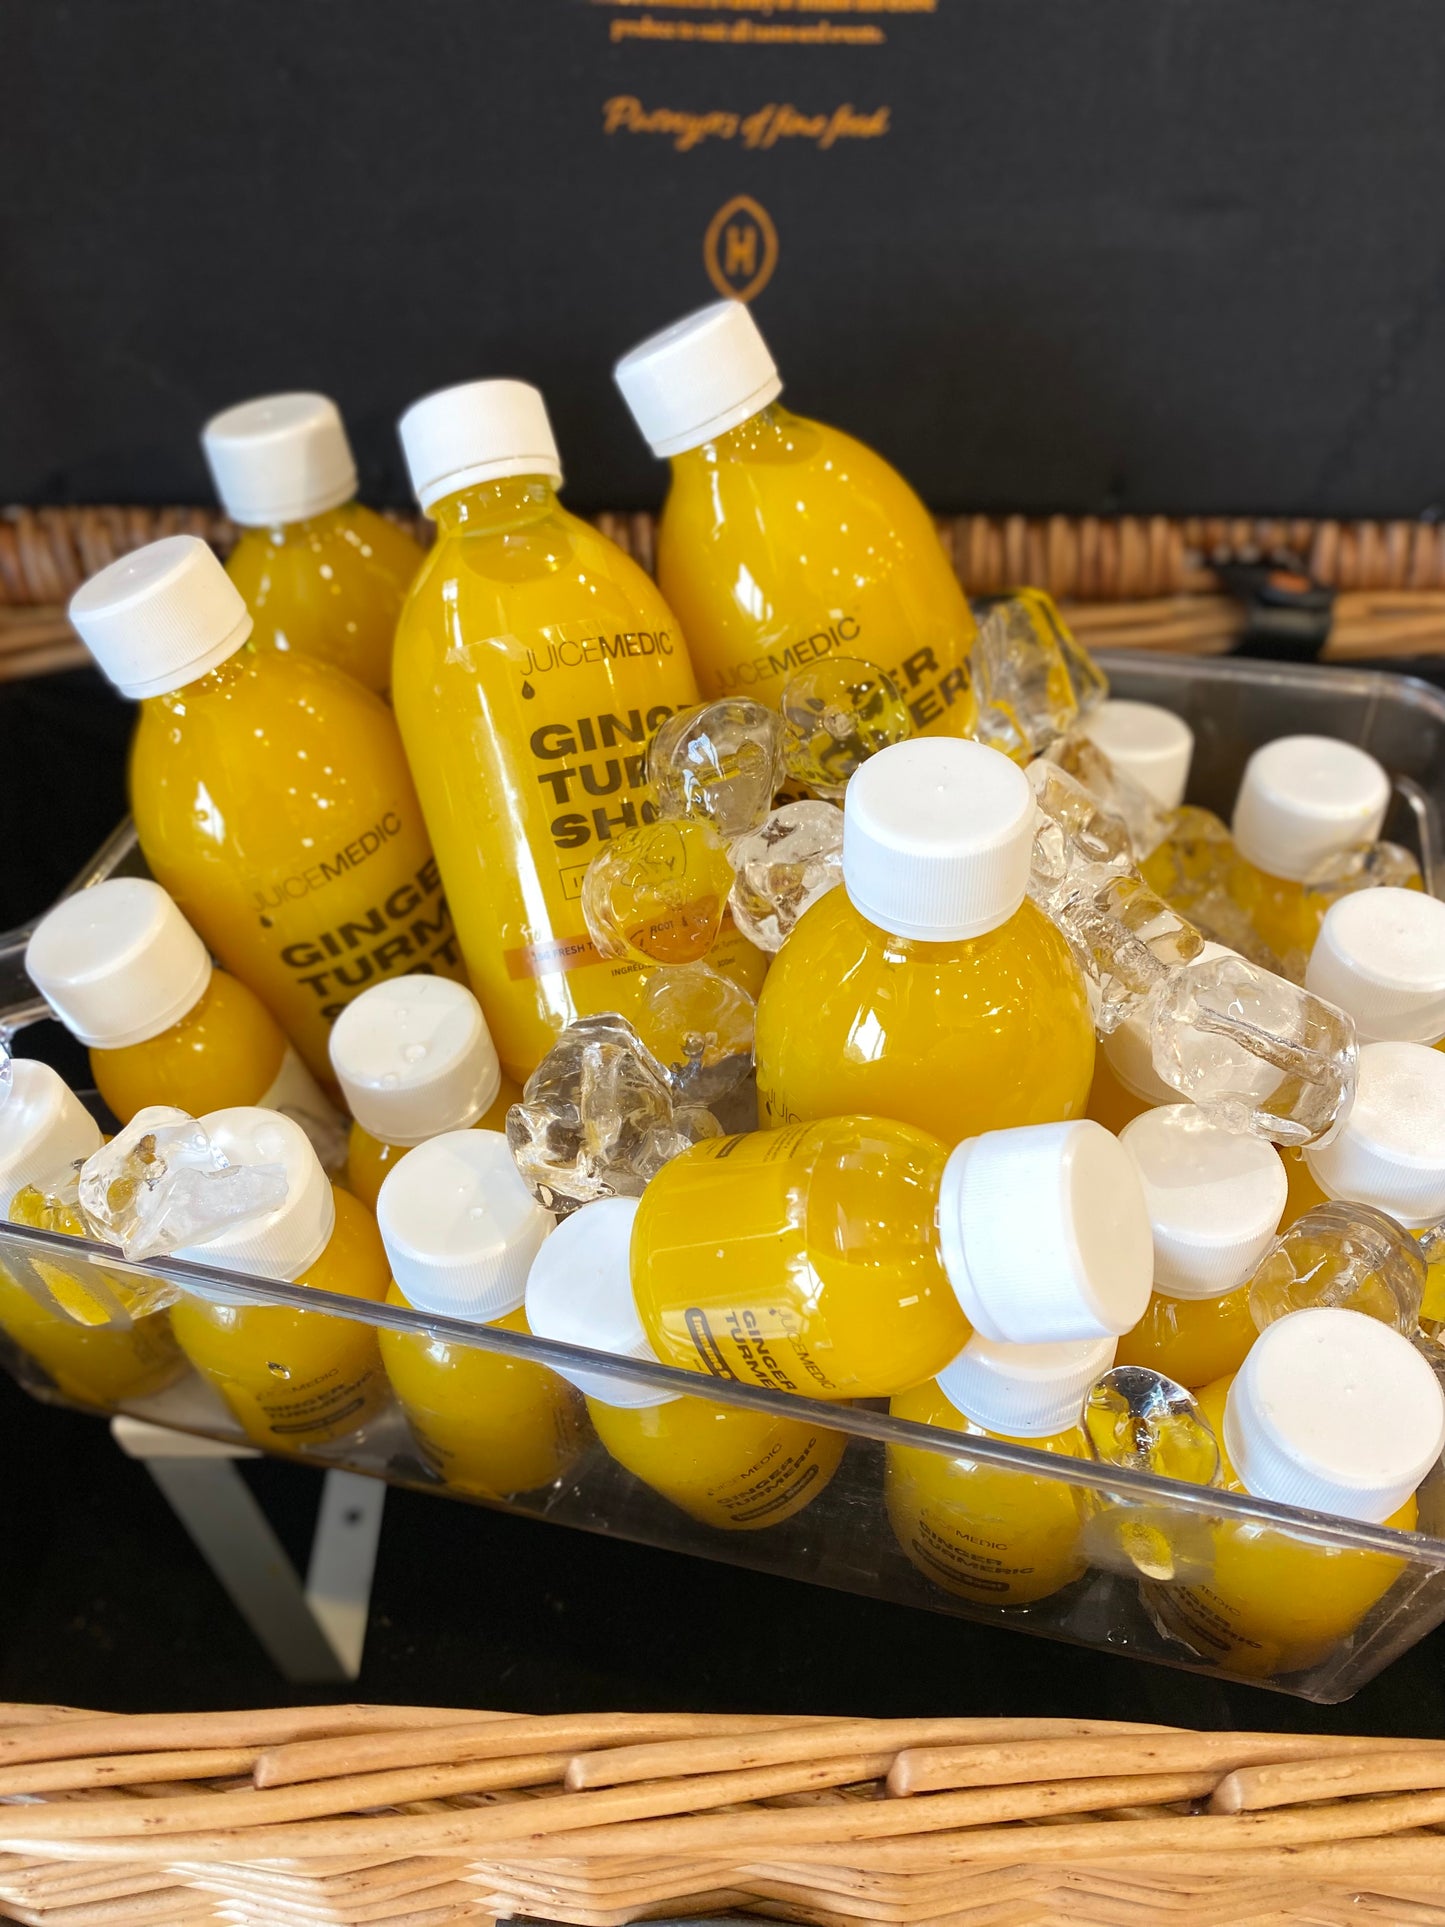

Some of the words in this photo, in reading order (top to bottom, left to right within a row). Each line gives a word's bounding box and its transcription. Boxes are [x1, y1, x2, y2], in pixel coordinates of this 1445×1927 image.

[725, 225, 757, 276] H
[520, 631, 674, 676] JUICEMEDIC
[716, 616, 861, 691] JUICEMEDIC
[252, 811, 402, 914] JUICEMEDIC
[280, 856, 443, 969] GINGE
[742, 1310, 798, 1391] GINGER
[777, 1309, 837, 1391] JUICEMEDIC
[717, 1457, 794, 1504] GINGER
[726, 1436, 817, 1509] TURMERIC
